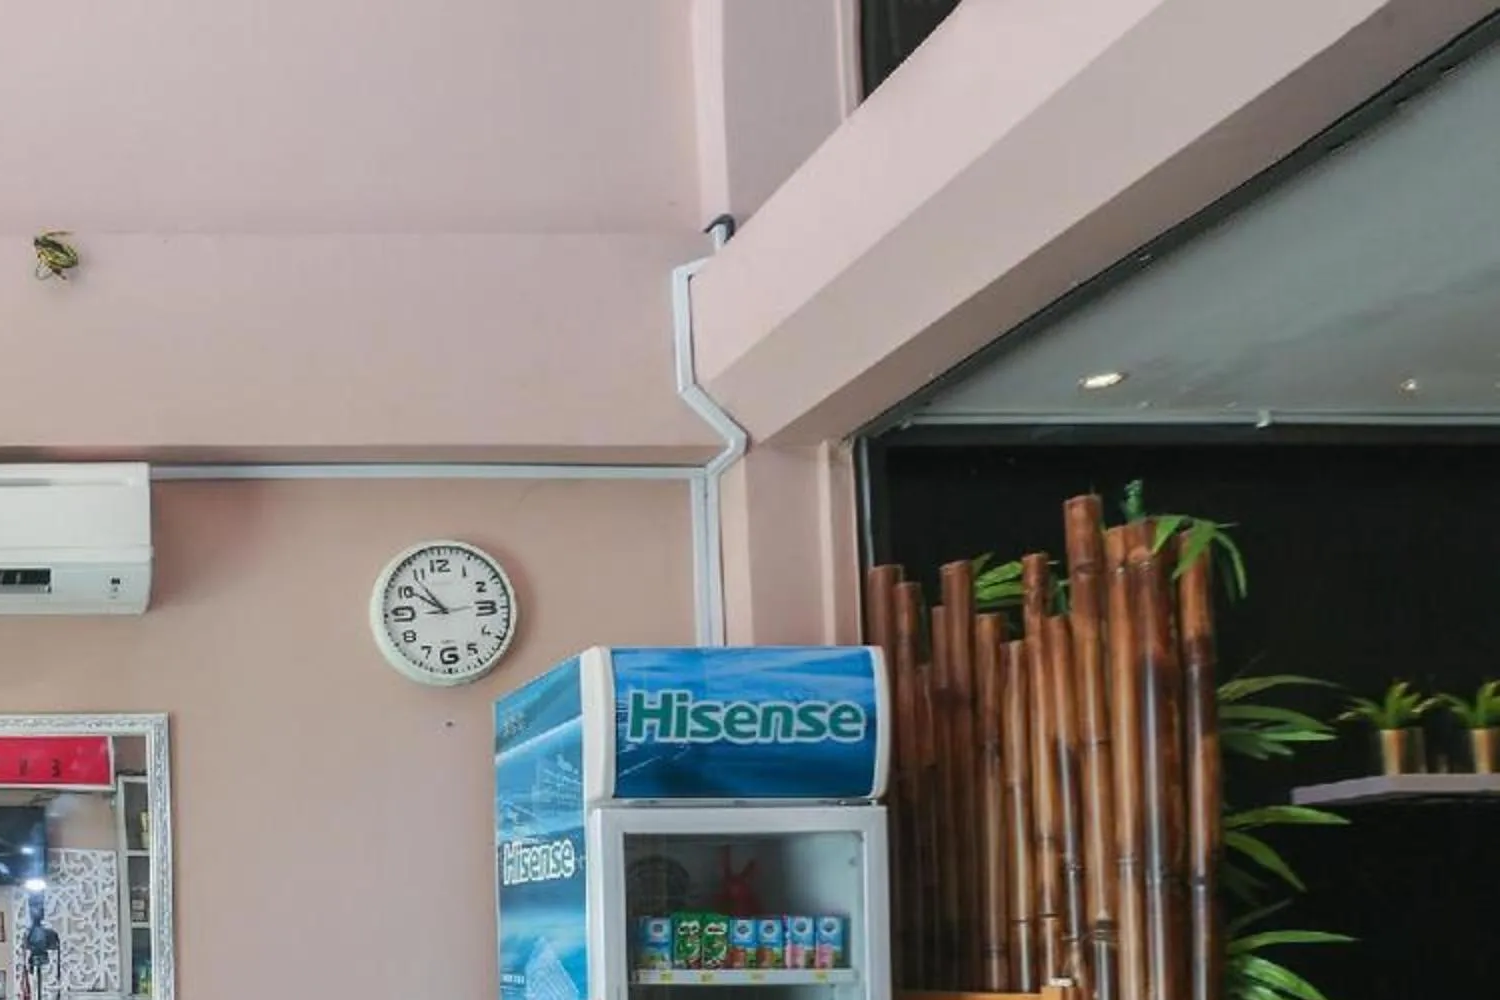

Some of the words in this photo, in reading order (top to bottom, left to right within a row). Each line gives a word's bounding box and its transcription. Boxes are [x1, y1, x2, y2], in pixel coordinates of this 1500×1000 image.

[429, 559, 451, 573] 12
[413, 568, 425, 580] 11
[398, 586, 414, 599] 10
[475, 581, 486, 593] 2
[391, 605, 416, 622] 9
[475, 600, 498, 617] 3
[403, 630, 417, 643] 8
[481, 624, 491, 636] 4
[421, 645, 432, 659] 7
[439, 646, 460, 664] 6
[466, 643, 478, 656] 5
[627, 689, 866, 744] Hisense
[502, 838, 575, 887] Hisense
